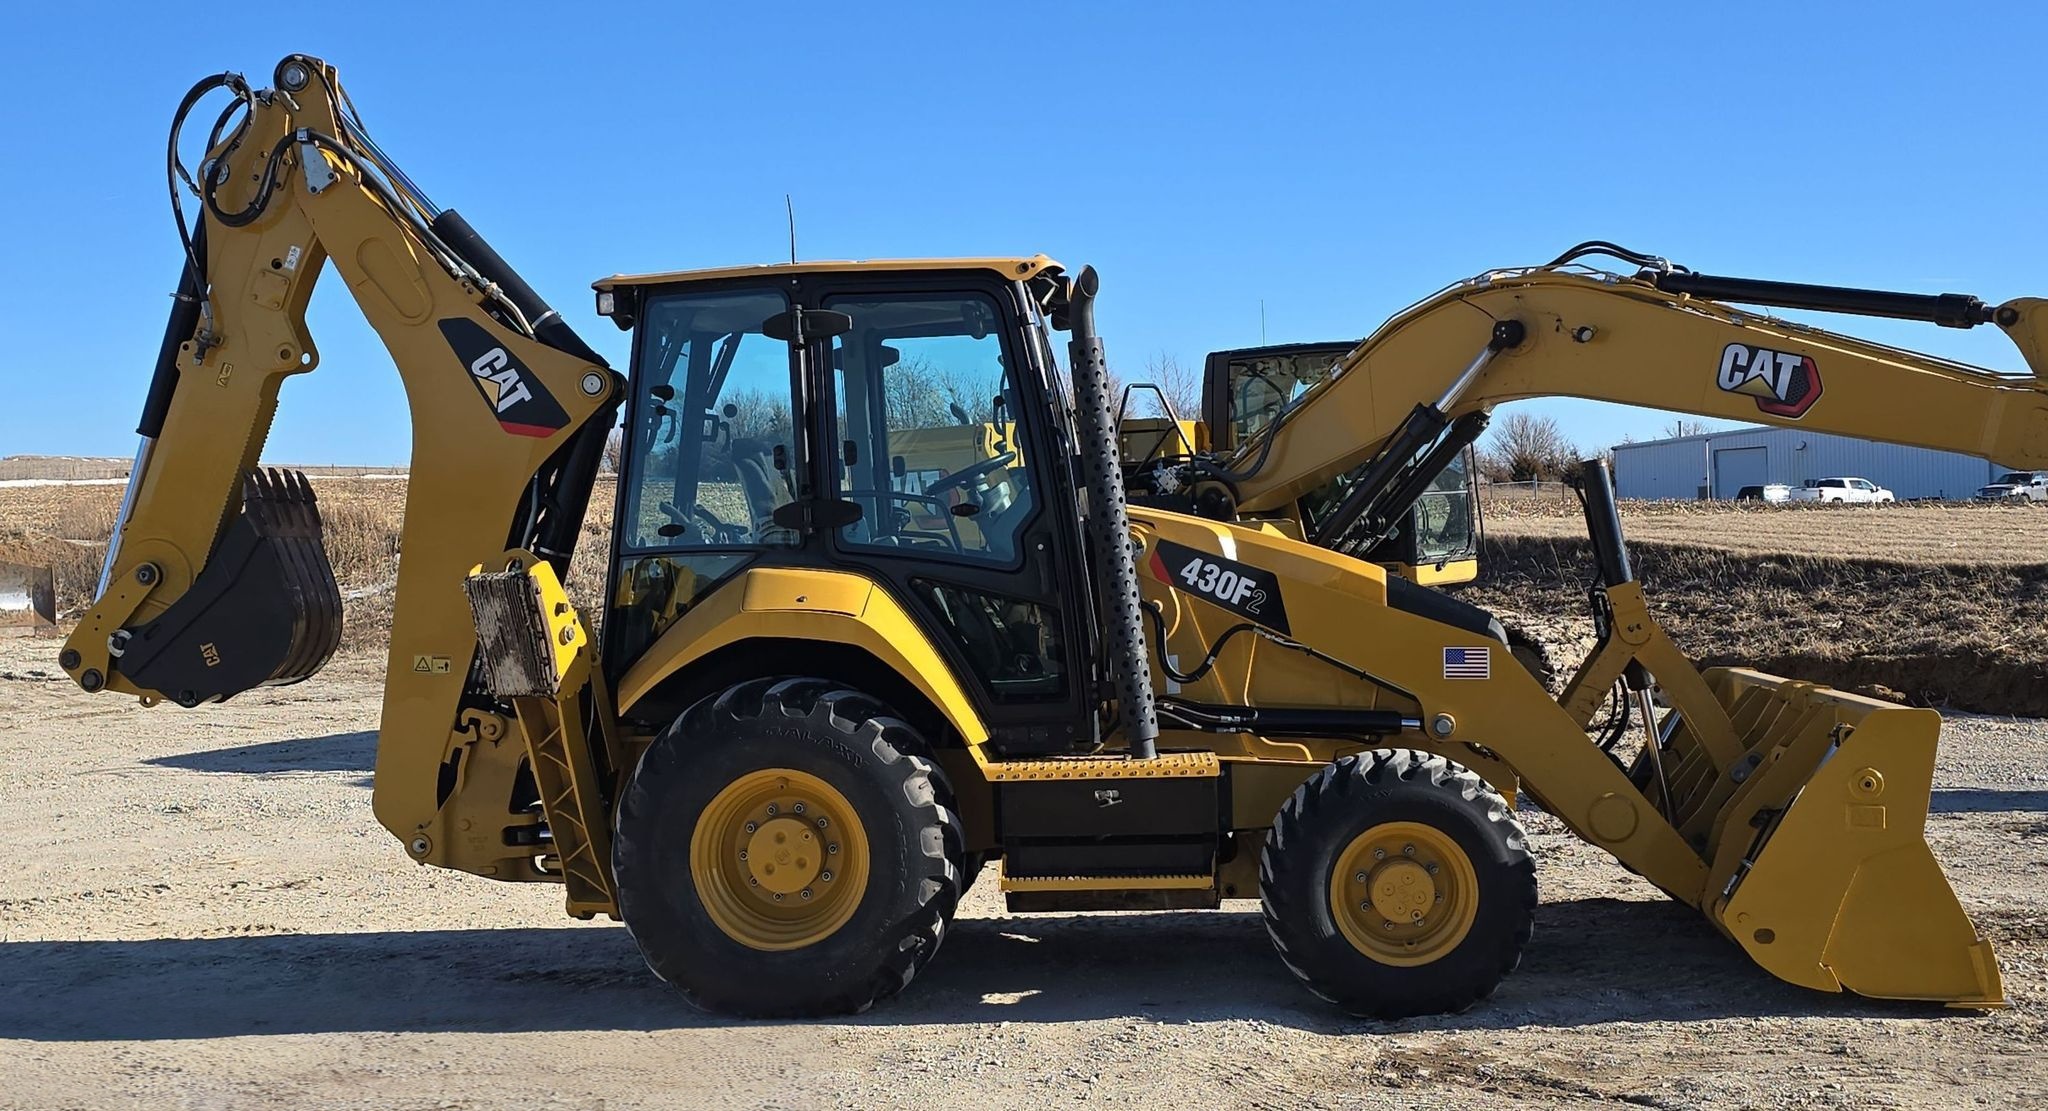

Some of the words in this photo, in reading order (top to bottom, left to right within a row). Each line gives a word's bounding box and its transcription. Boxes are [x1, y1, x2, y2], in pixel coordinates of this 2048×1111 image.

[471, 347, 533, 414] CAT
[1718, 344, 1802, 401] CAT
[200, 642, 220, 667] CAT
